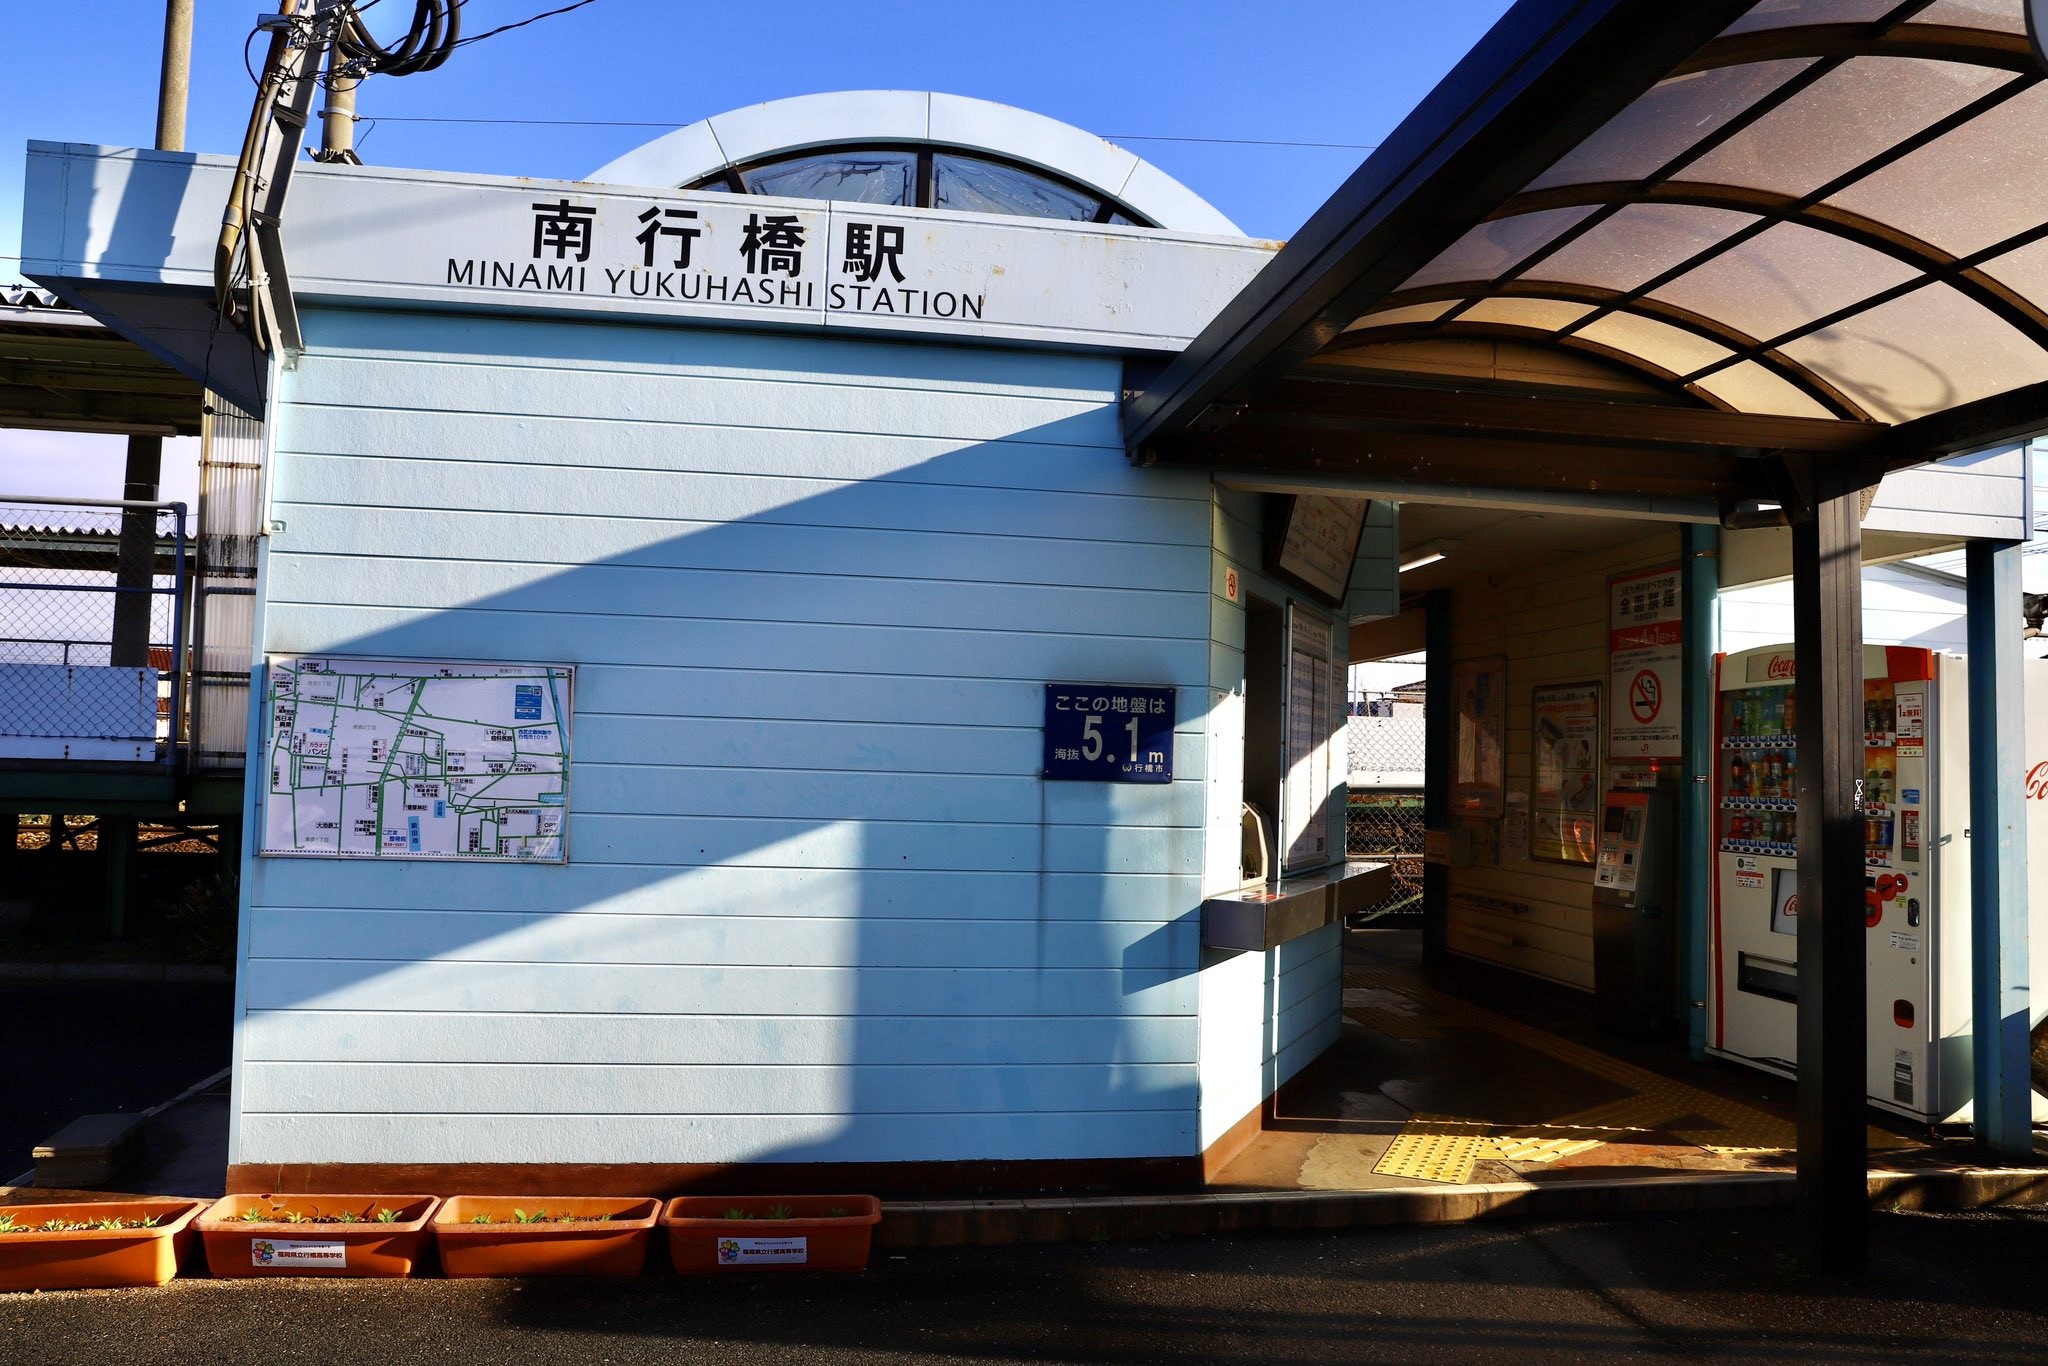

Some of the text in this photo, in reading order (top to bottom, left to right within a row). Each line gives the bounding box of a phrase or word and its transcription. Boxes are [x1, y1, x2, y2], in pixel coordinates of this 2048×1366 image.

[531, 199, 907, 284] 南行橋駅
[446, 257, 985, 320] MINAMI YUKUHASHI STATION
[1055, 695, 1166, 714] ここの地盤は
[1054, 715, 1164, 764] 海抜 5.1 m
[1134, 763, 1164, 773] 行橋市
[277, 1251, 343, 1260] 福岡県立行橋高等学校
